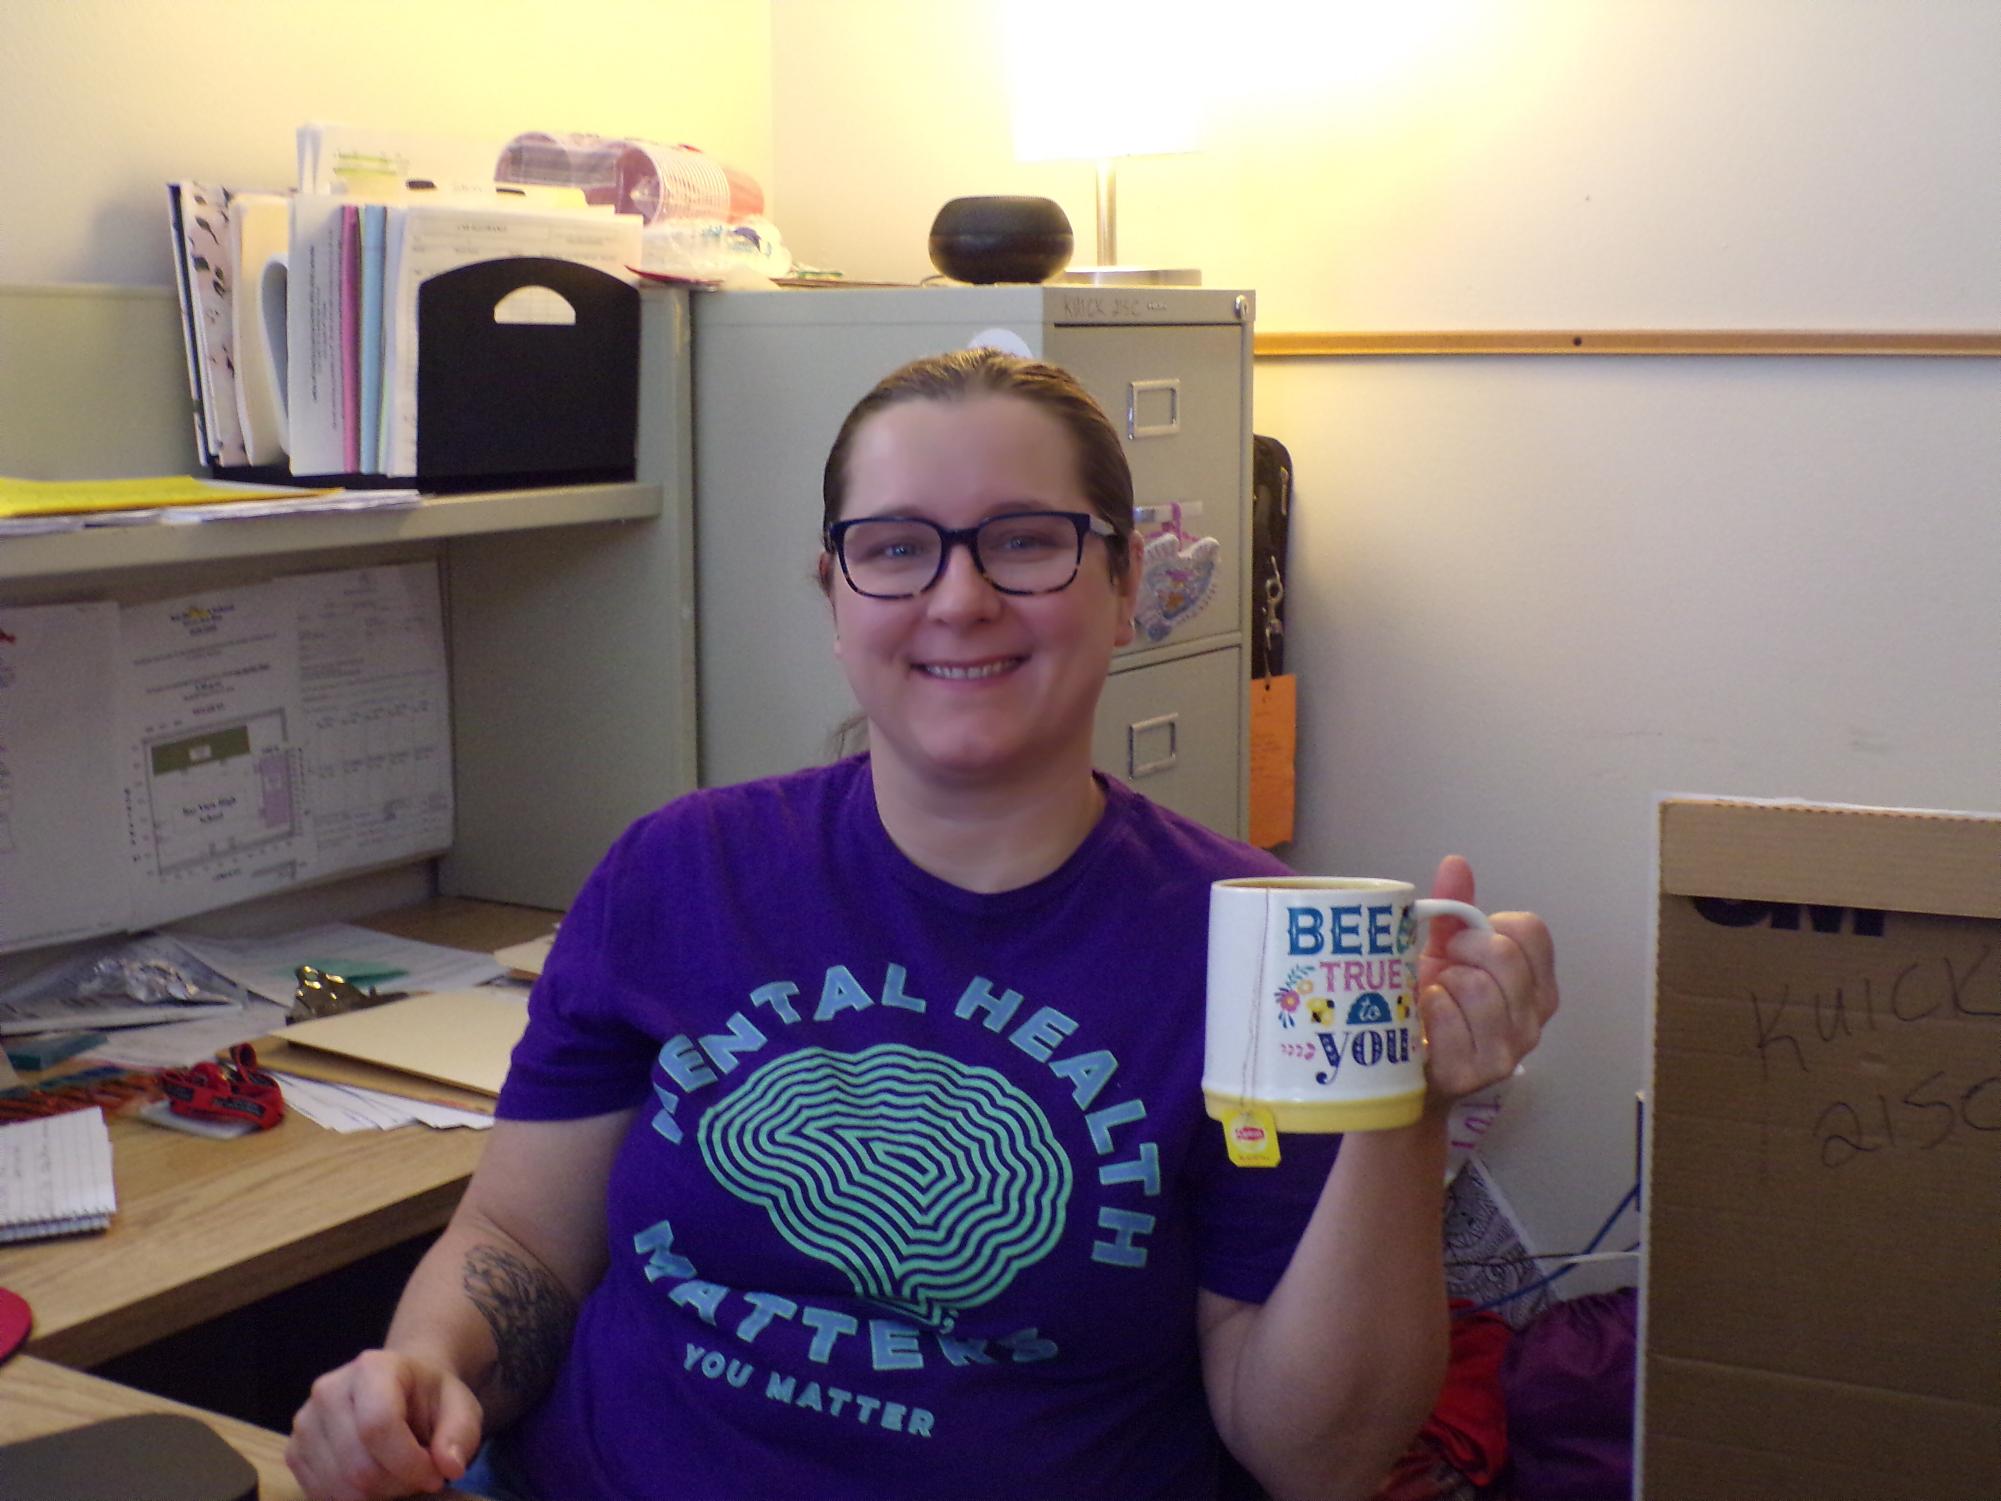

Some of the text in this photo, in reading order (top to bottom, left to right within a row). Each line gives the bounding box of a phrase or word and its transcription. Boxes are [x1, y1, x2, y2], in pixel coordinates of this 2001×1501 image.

[1287, 904, 1395, 956] BEE
[1319, 959, 1404, 993] TRUE
[1358, 993, 1382, 1022] to
[1314, 1027, 1410, 1086] you
[953, 975, 1161, 1268] HEALTH
[682, 1342, 936, 1438] YOU MATTER
